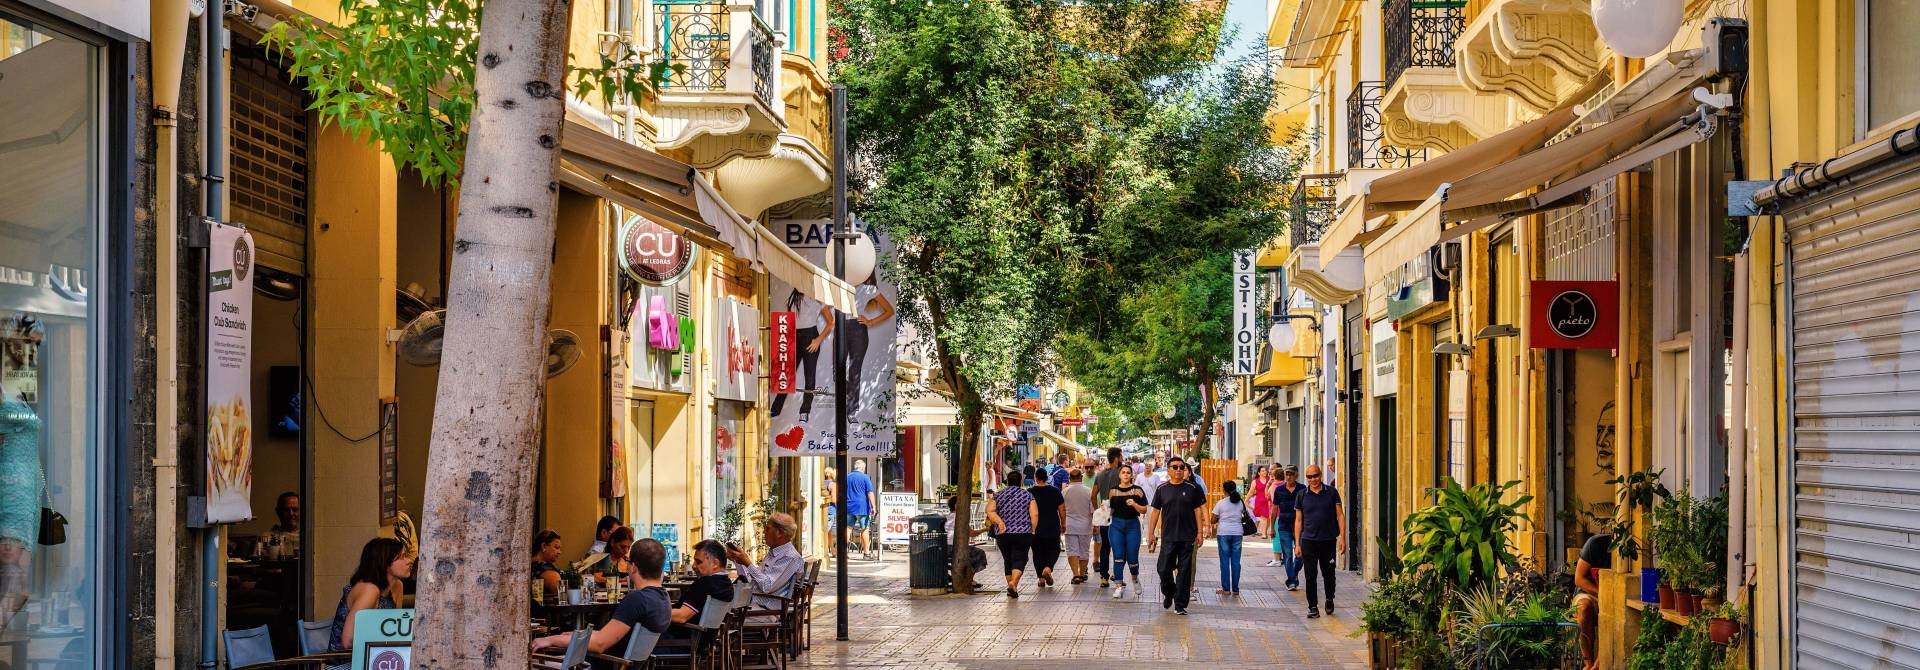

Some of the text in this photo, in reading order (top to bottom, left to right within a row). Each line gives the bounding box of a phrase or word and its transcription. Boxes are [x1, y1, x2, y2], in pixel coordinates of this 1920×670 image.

[221, 302, 240, 314] Chicken
[214, 316, 247, 331] Club Sandwich
[1558, 315, 1590, 329] pieto
[778, 315, 788, 390] KRASHIAS
[853, 431, 877, 439] School
[808, 440, 834, 450] Back
